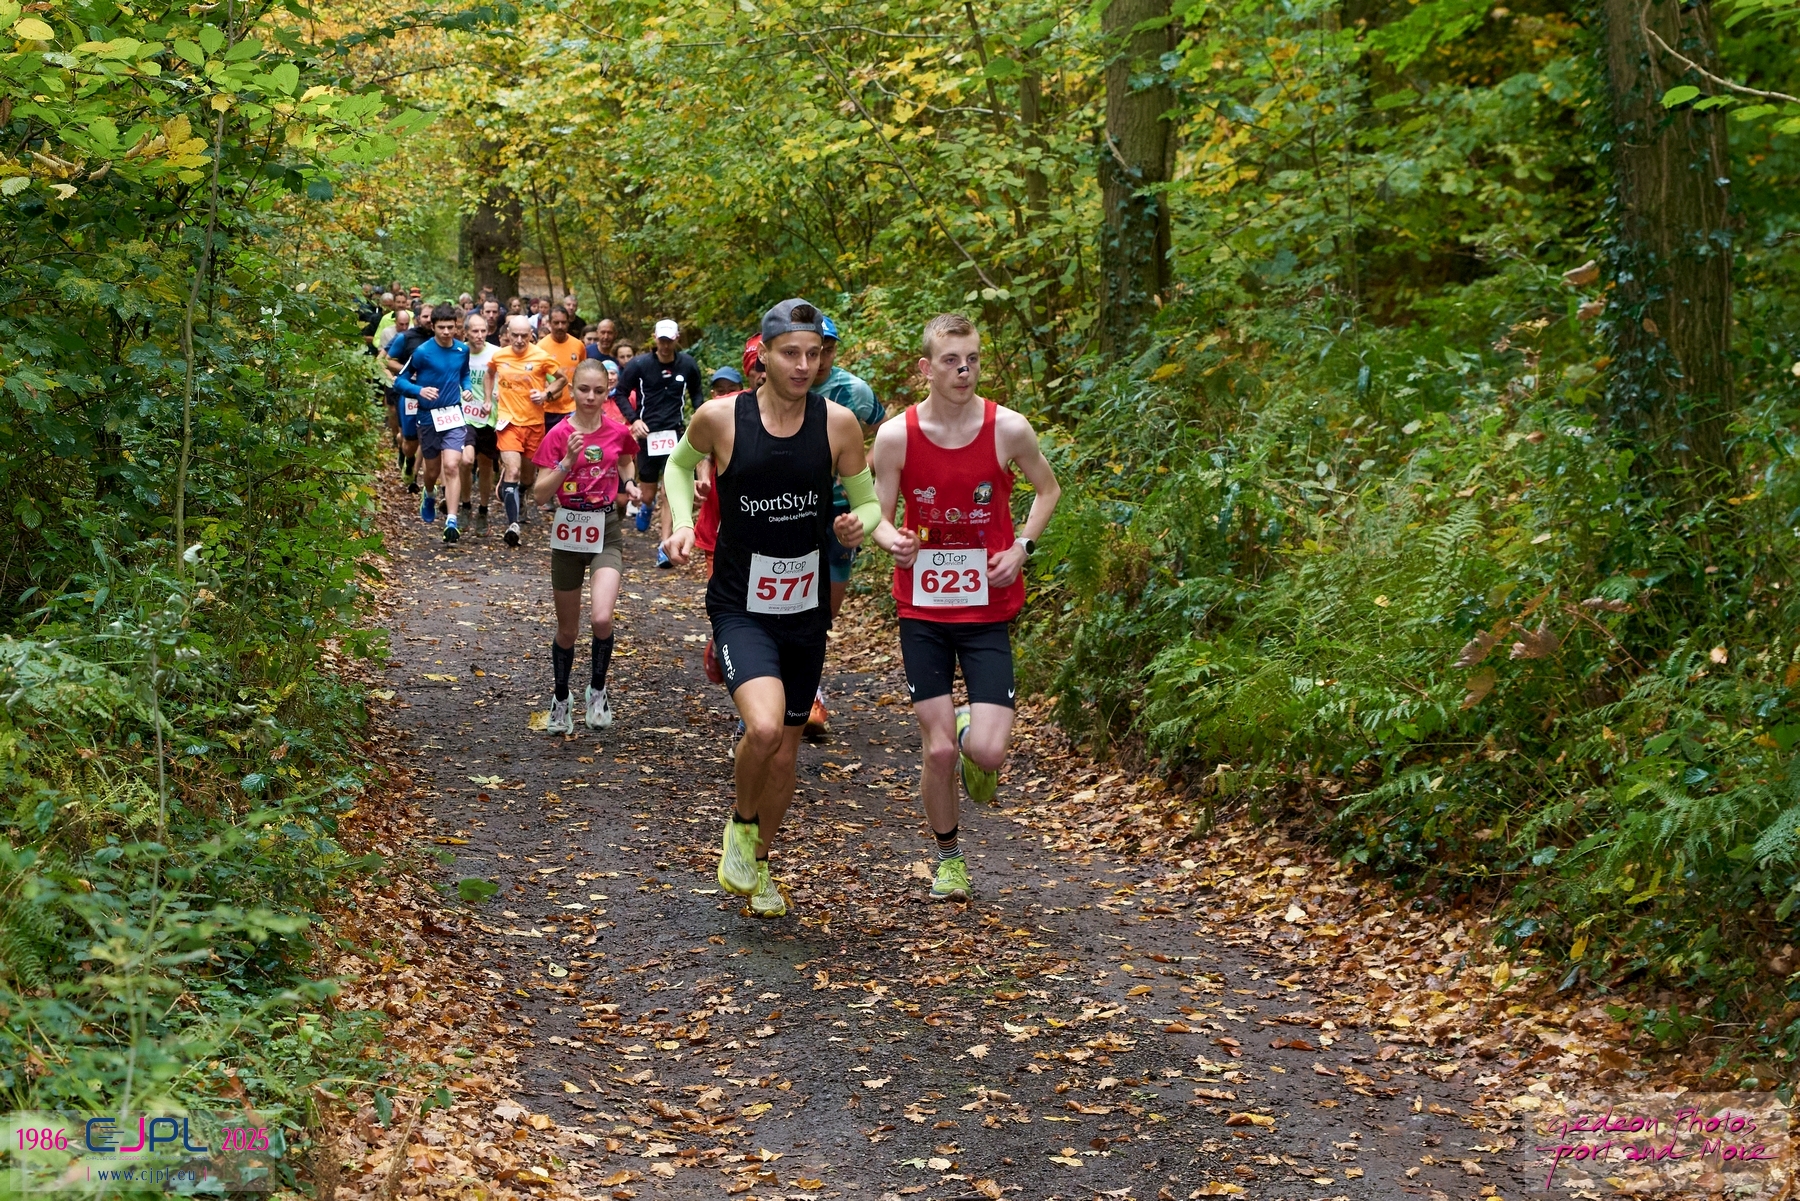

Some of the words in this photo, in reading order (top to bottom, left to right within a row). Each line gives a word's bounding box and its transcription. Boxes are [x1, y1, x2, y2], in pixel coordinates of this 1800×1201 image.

[436, 413, 461, 426] 586
[651, 438, 675, 451] 579
[739, 490, 819, 517] SportStyle
[575, 513, 592, 523] Top
[556, 522, 600, 544] 619
[786, 560, 807, 572] Top
[945, 552, 968, 565] Top
[755, 571, 815, 601] 577
[920, 568, 982, 594] 623
[722, 643, 734, 672] CRAFT
